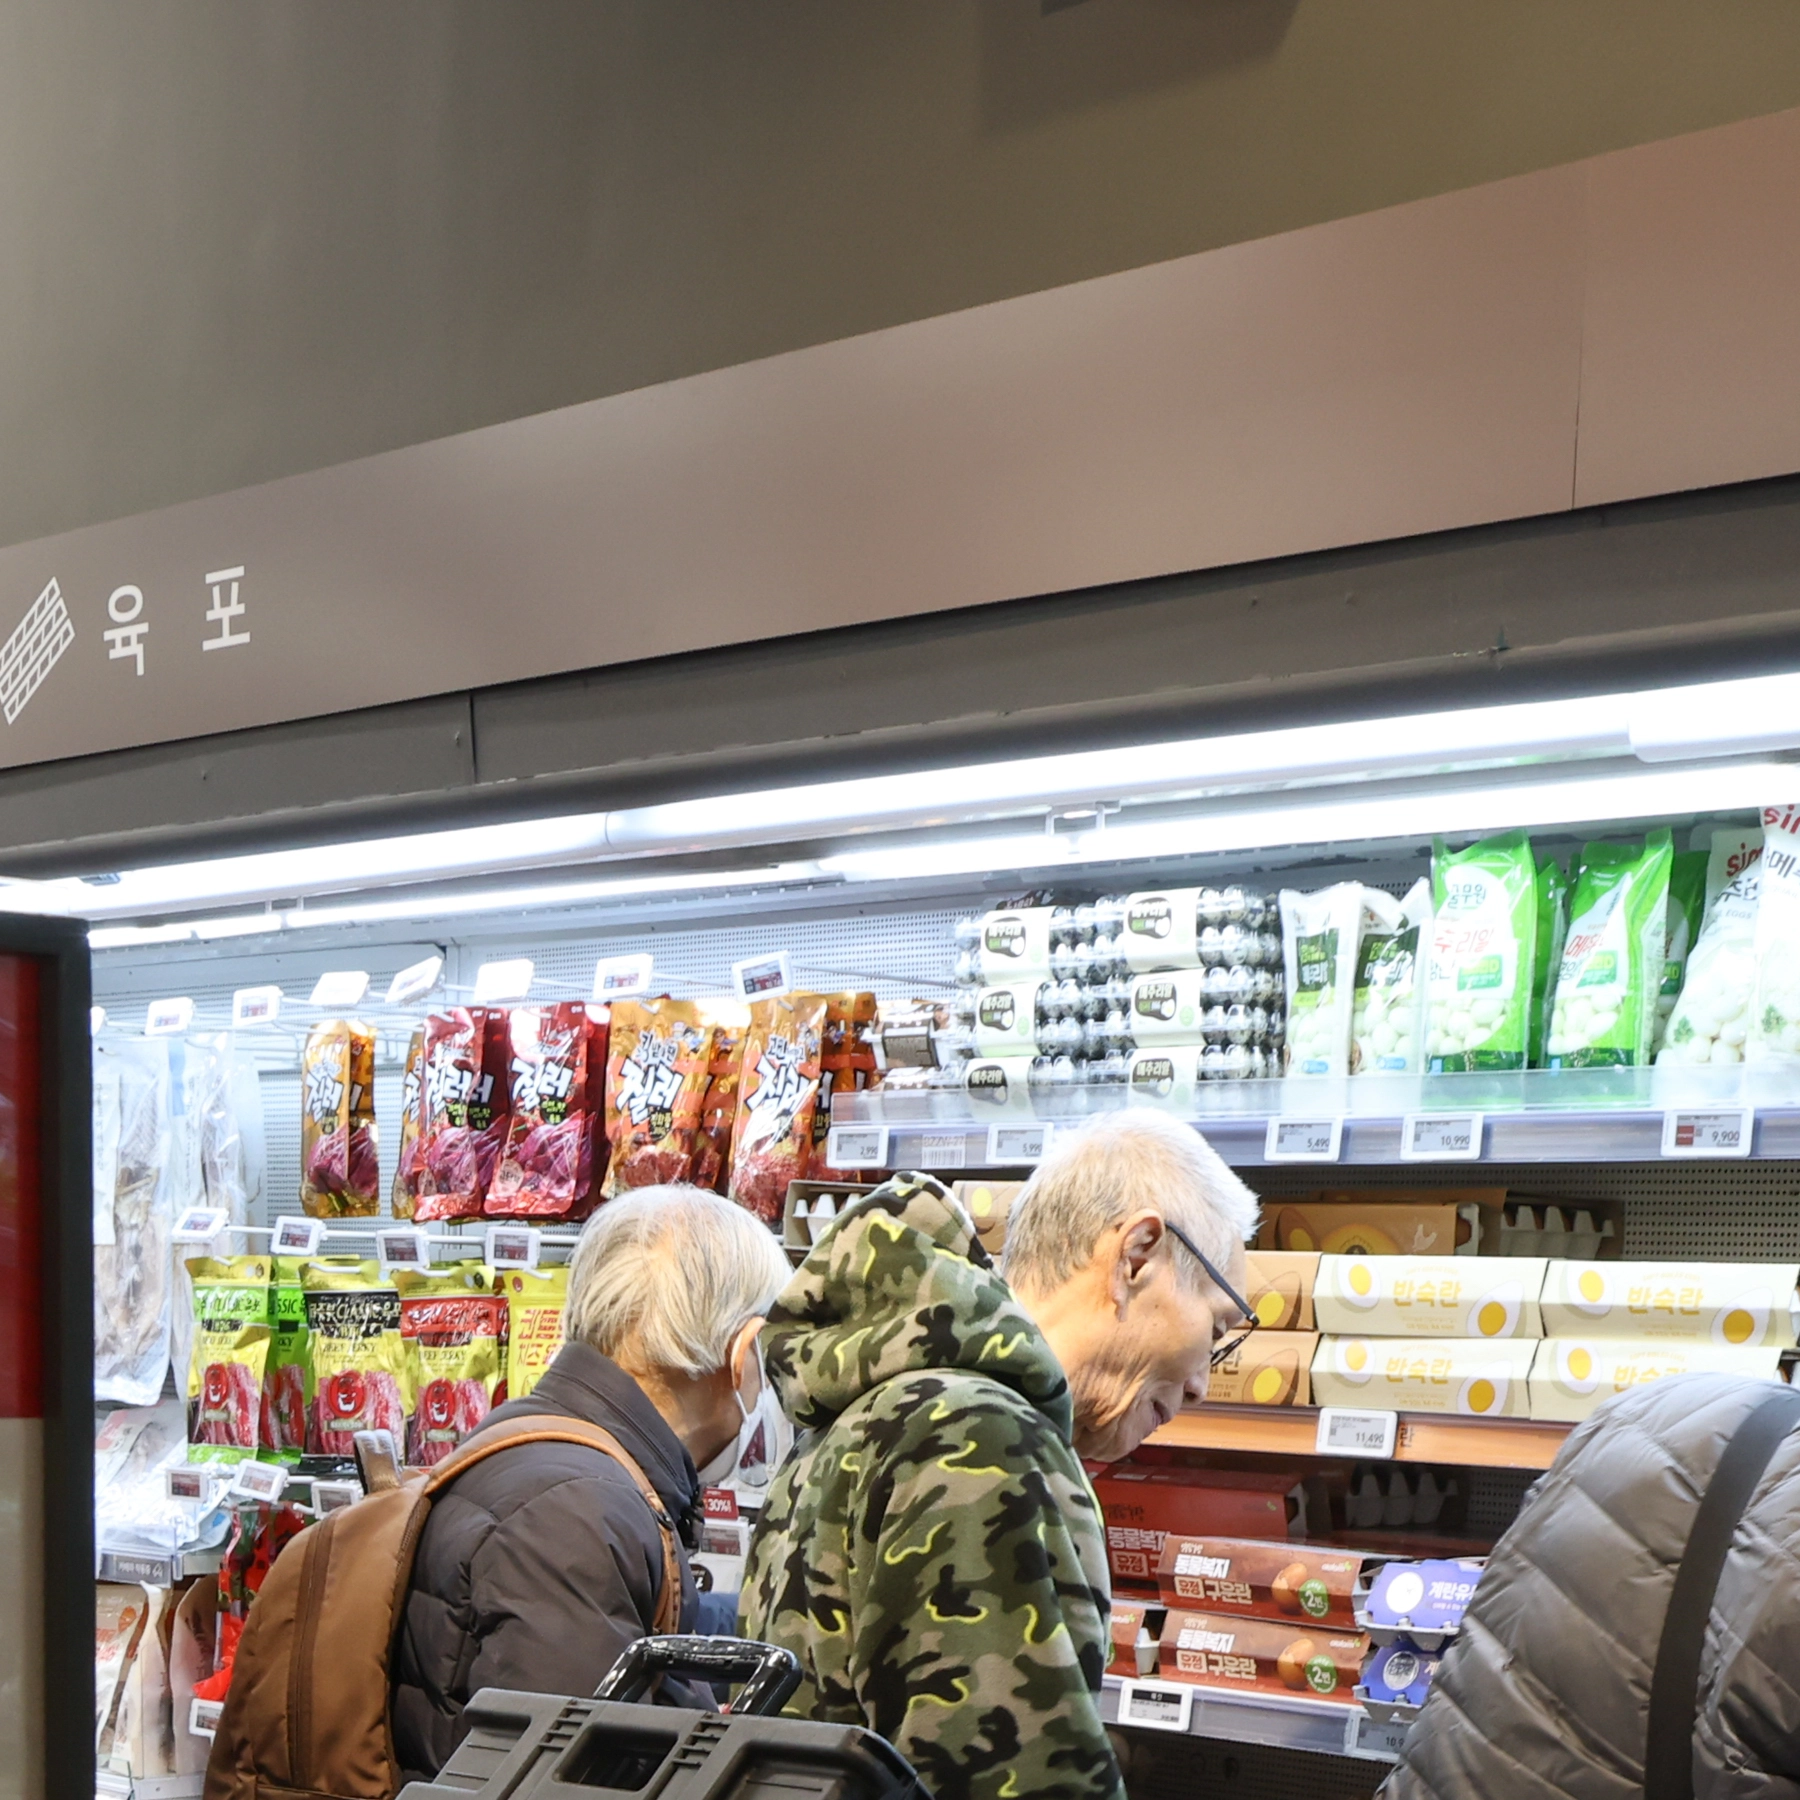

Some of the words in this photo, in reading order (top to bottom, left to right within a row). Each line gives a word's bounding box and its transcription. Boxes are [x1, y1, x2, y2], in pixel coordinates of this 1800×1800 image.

[1440, 1134, 1470, 1148] 10,990
[1712, 1130, 1739, 1142] 9,900
[1393, 1280, 1461, 1308] 반숙란
[1627, 1287, 1703, 1316] 반숙란
[1386, 1358, 1452, 1385] 반숙란
[1355, 1431, 1385, 1444] 11,490
